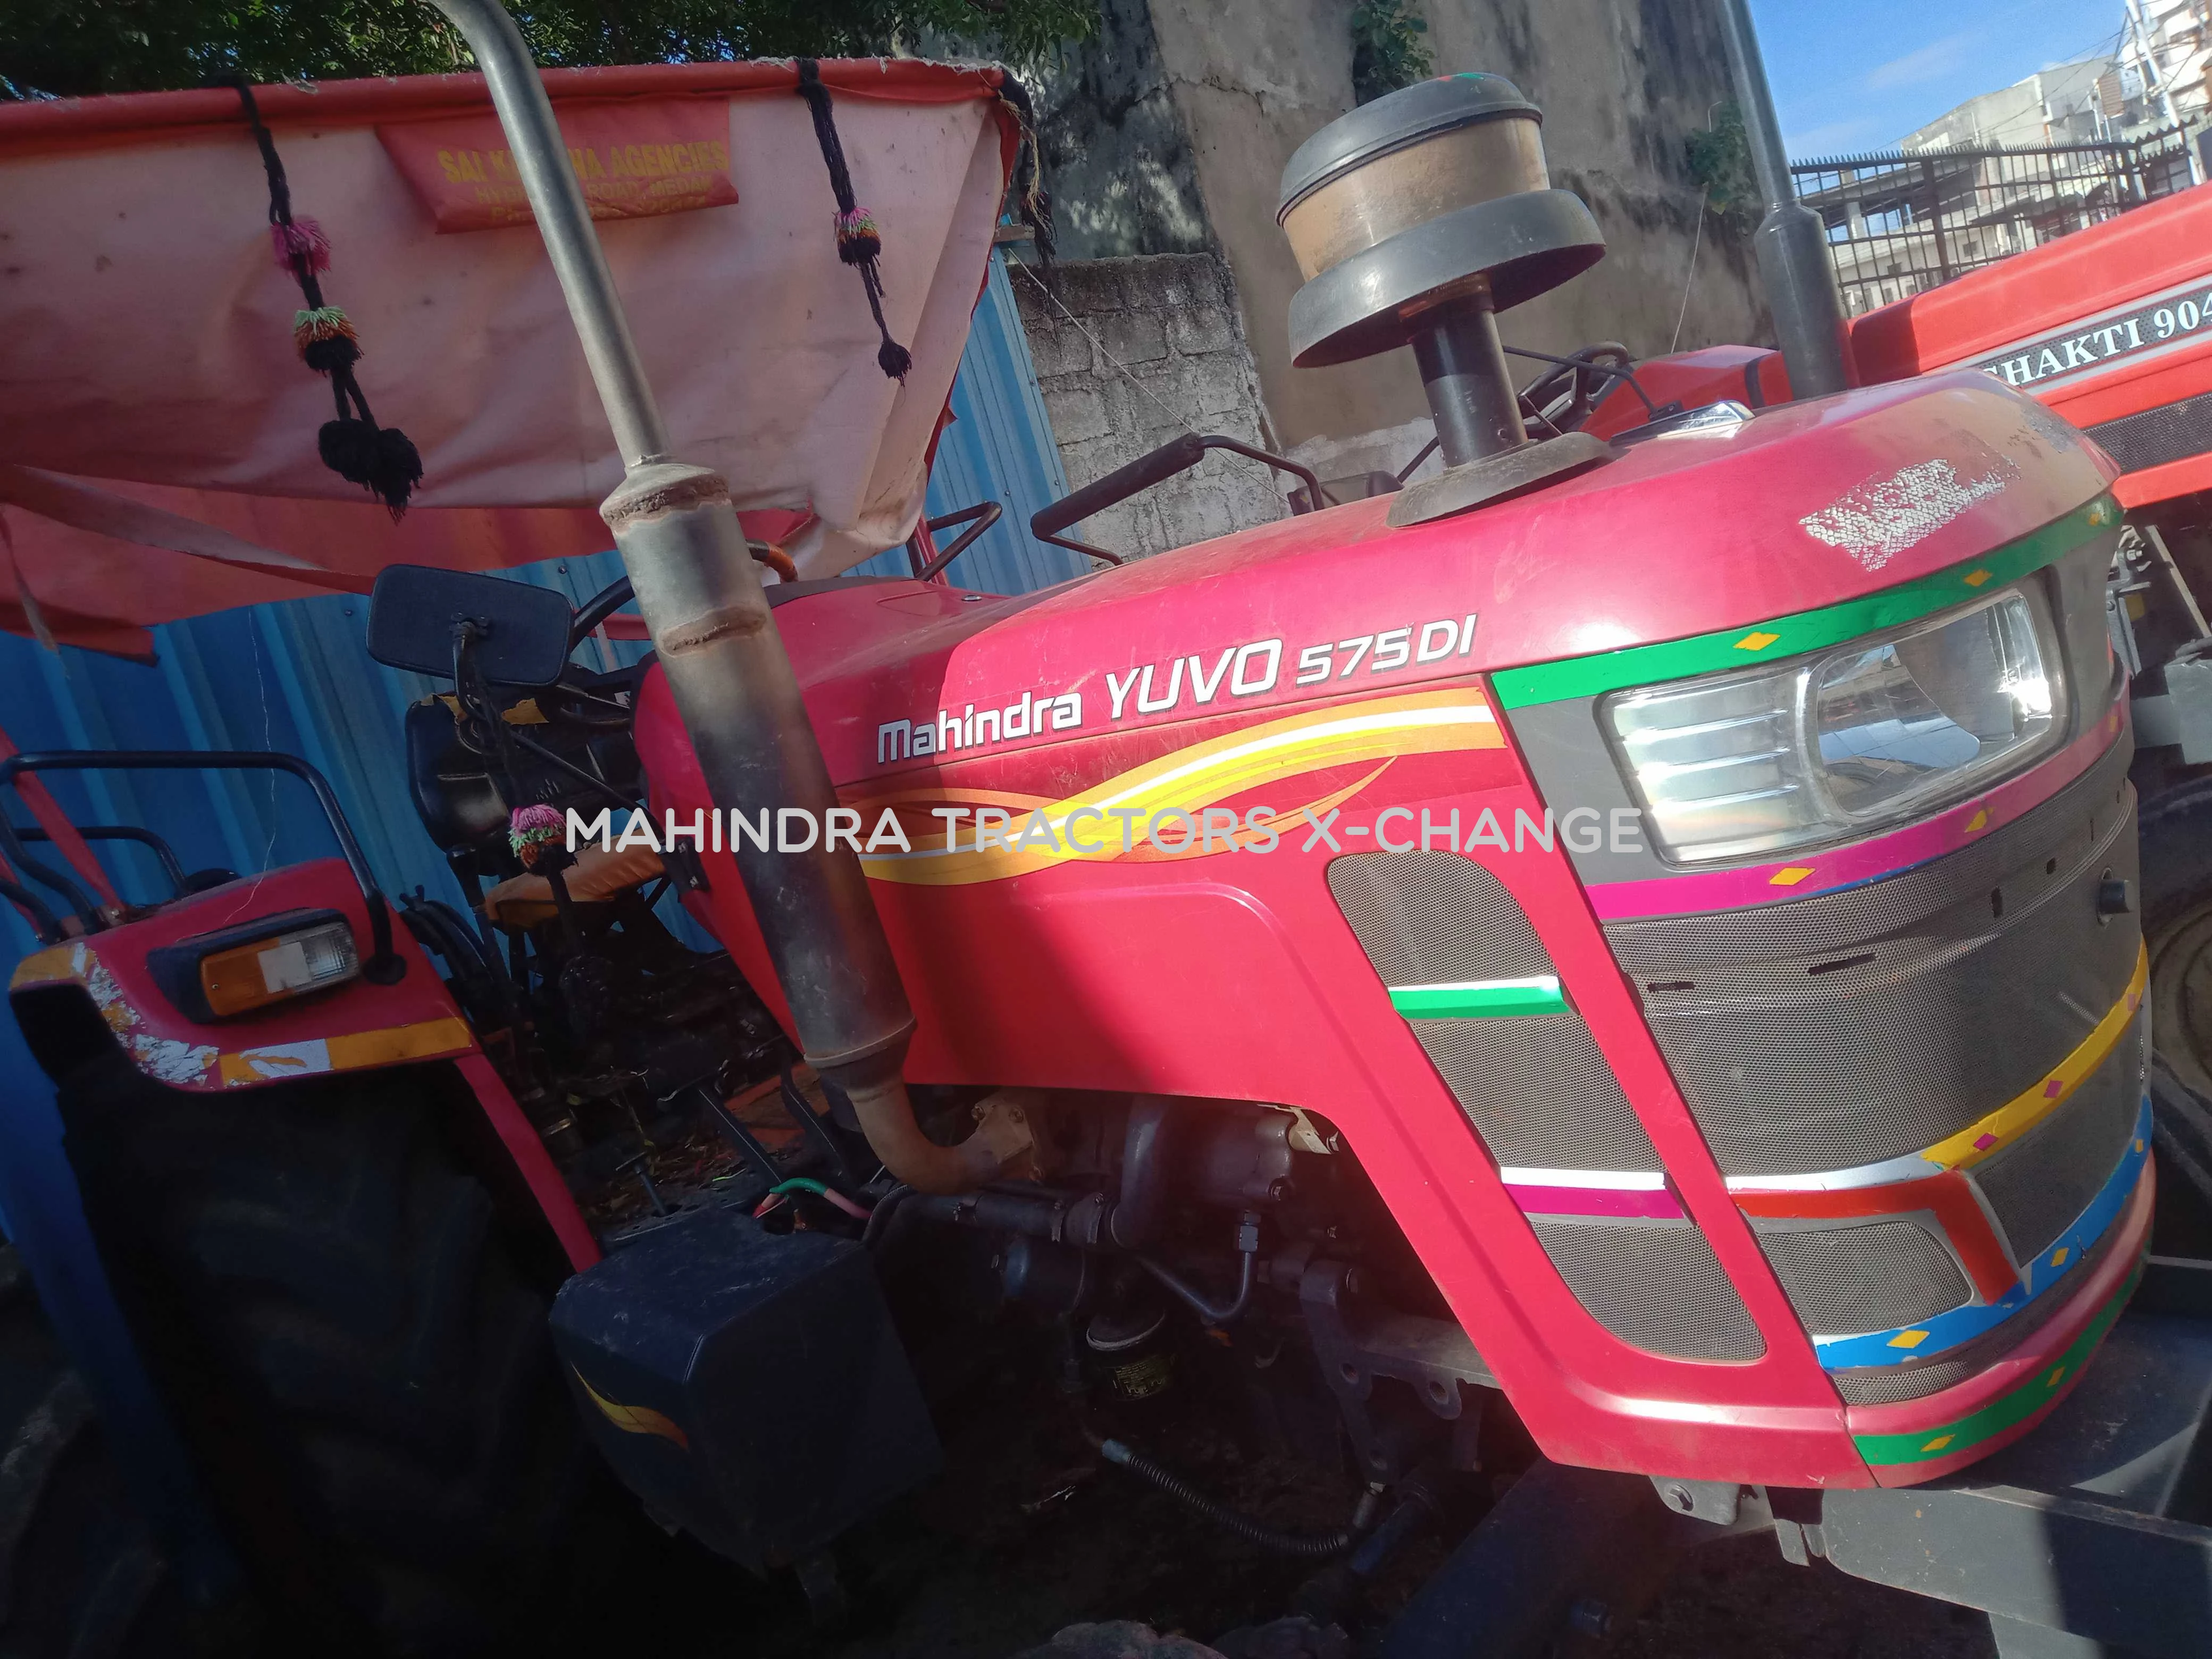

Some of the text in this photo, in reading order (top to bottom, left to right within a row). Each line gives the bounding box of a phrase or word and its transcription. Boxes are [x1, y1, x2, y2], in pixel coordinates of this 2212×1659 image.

[439, 150, 489, 183] SAI
[610, 141, 728, 177] AGENCIES
[1982, 317, 2146, 387] HAKTI
[877, 691, 1083, 764] Mahindra
[1105, 638, 1283, 720] YUVO
